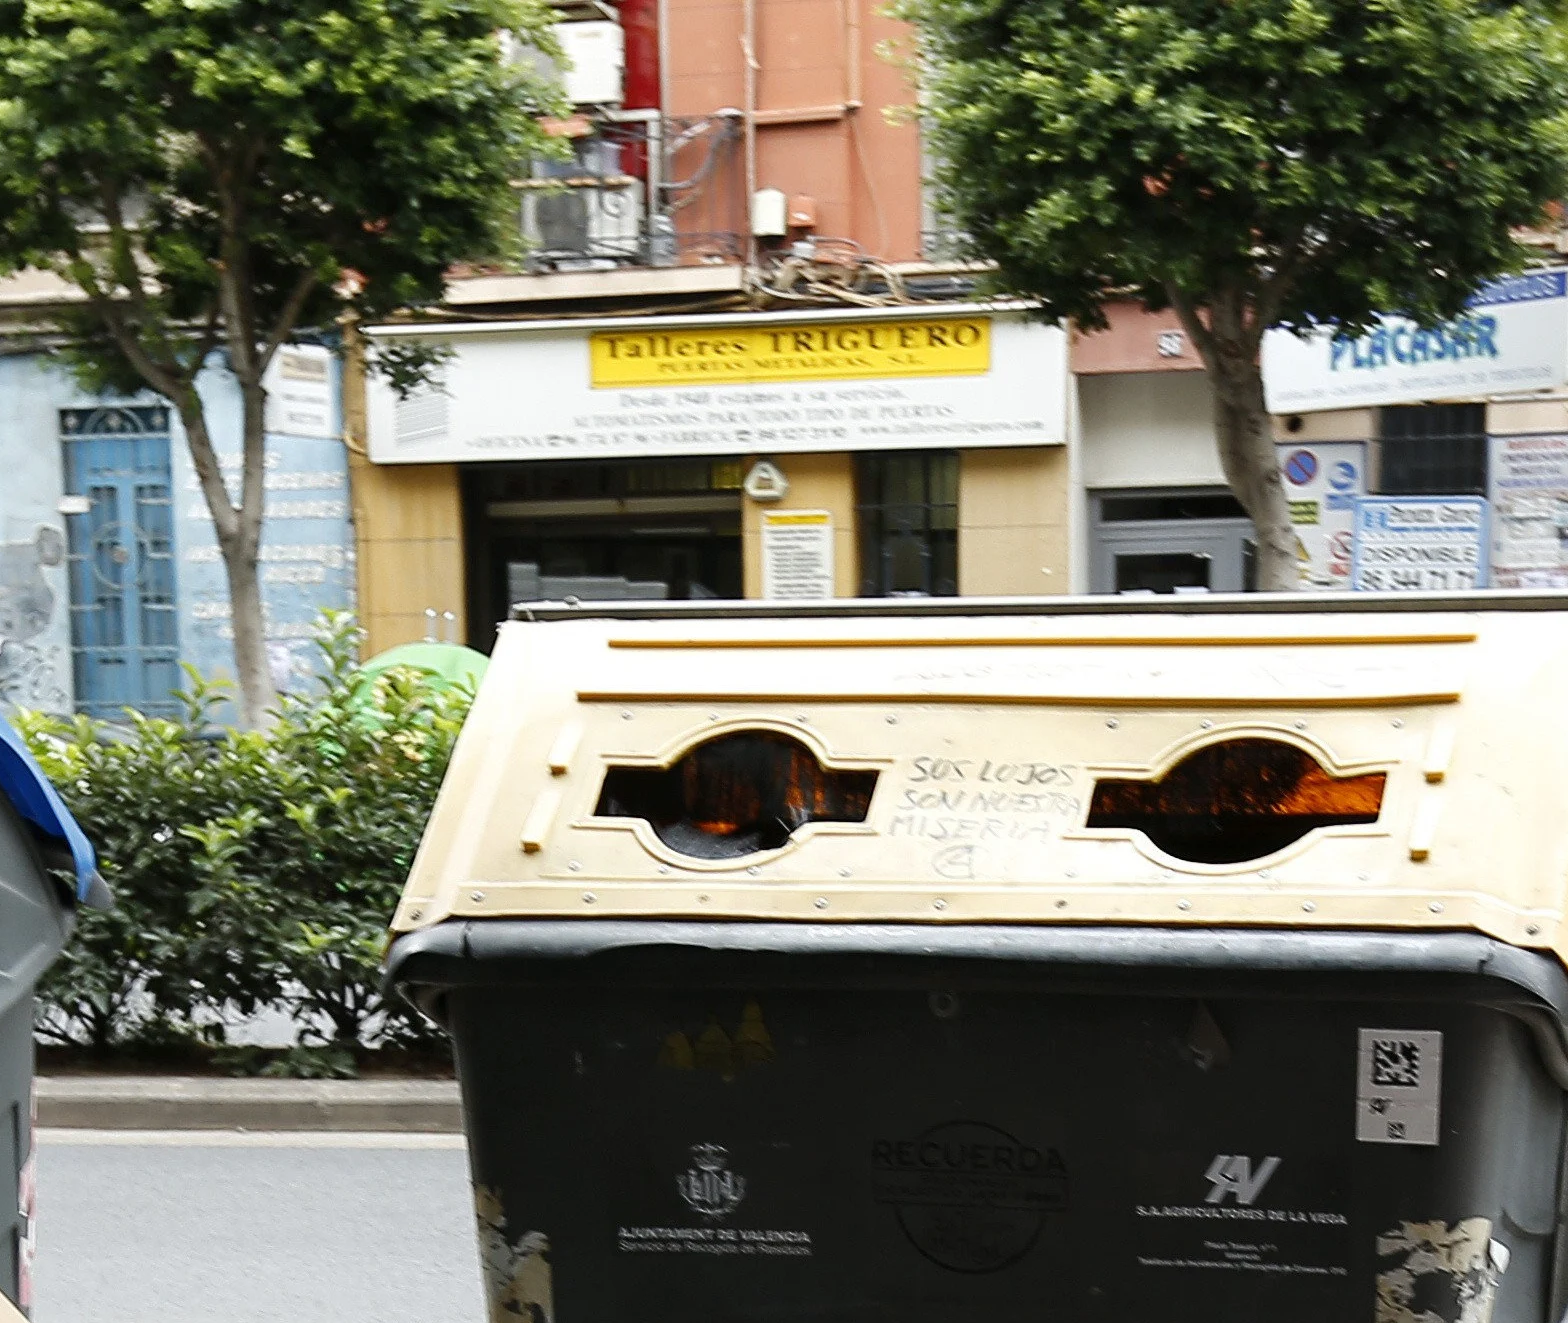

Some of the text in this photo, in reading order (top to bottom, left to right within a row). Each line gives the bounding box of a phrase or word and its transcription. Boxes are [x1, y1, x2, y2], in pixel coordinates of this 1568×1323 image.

[604, 323, 983, 360] Talleres TRIGUERO
[657, 359, 745, 373] PUERTAS
[881, 403, 956, 418] PUERTAS
[1362, 545, 1478, 564] DISPONIBLE
[872, 1138, 1068, 1174] RECUERDA
[716, 1228, 738, 1242] DE
